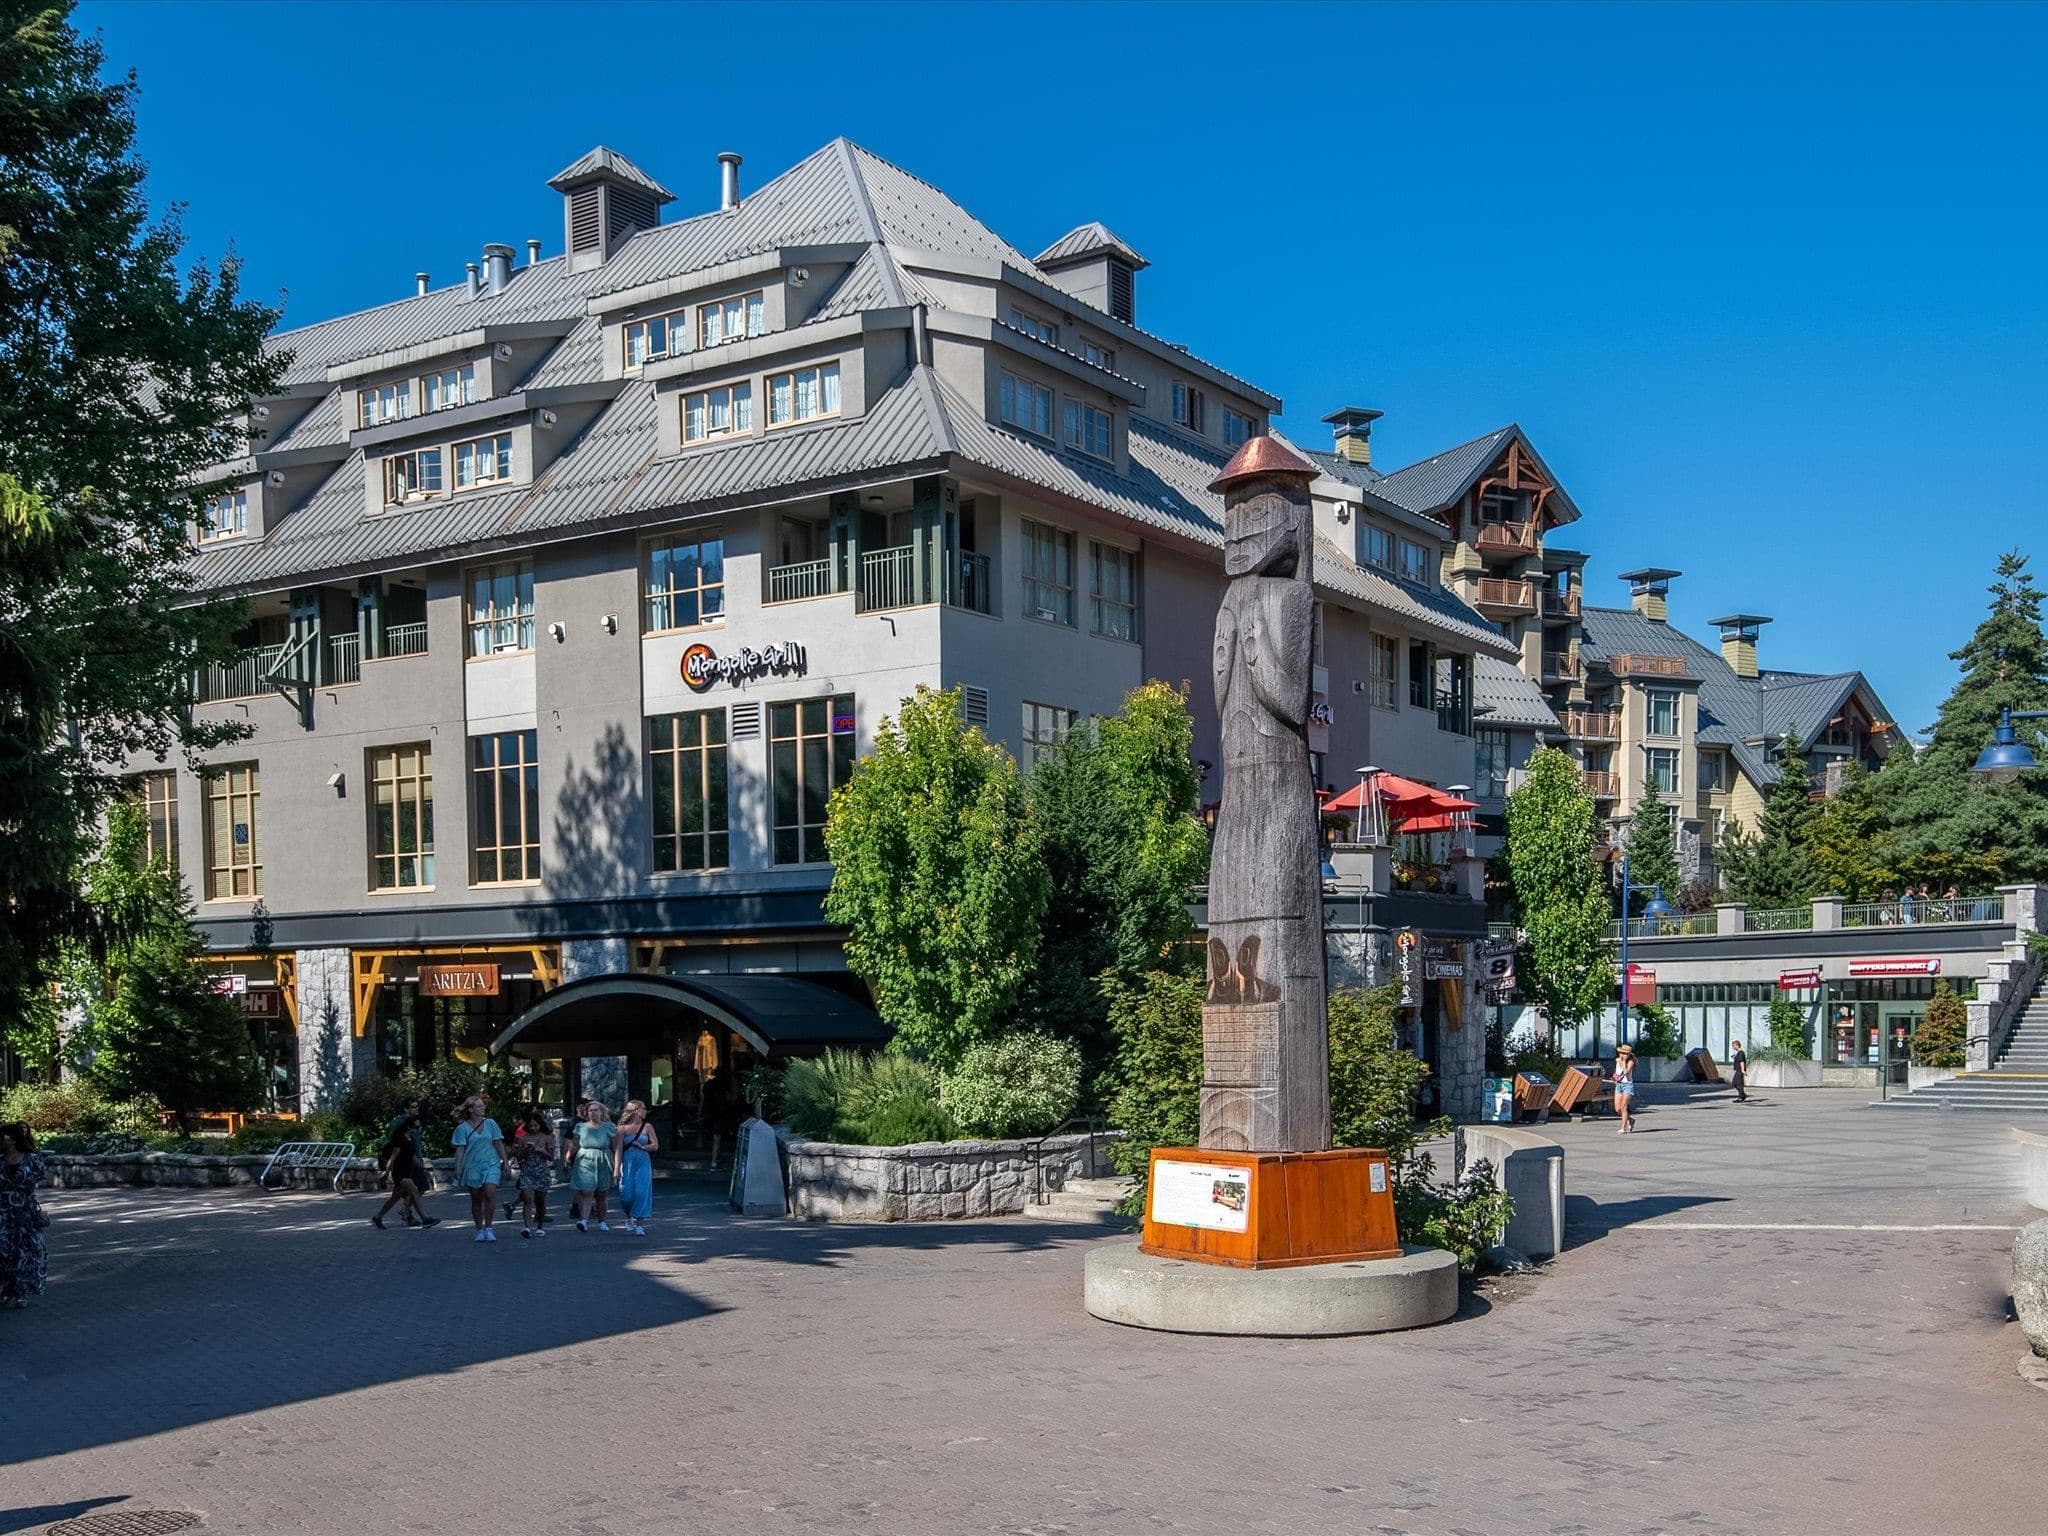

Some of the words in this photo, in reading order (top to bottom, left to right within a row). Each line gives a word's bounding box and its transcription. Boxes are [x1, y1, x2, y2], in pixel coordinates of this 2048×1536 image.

[687, 647, 758, 677] Mongolie
[761, 641, 800, 668] Grill
[1399, 925, 1413, 981] Mongolie
[1435, 964, 1463, 976] CINEMAS
[1490, 958, 1508, 976] 8
[432, 972, 486, 990] ARITZIA
